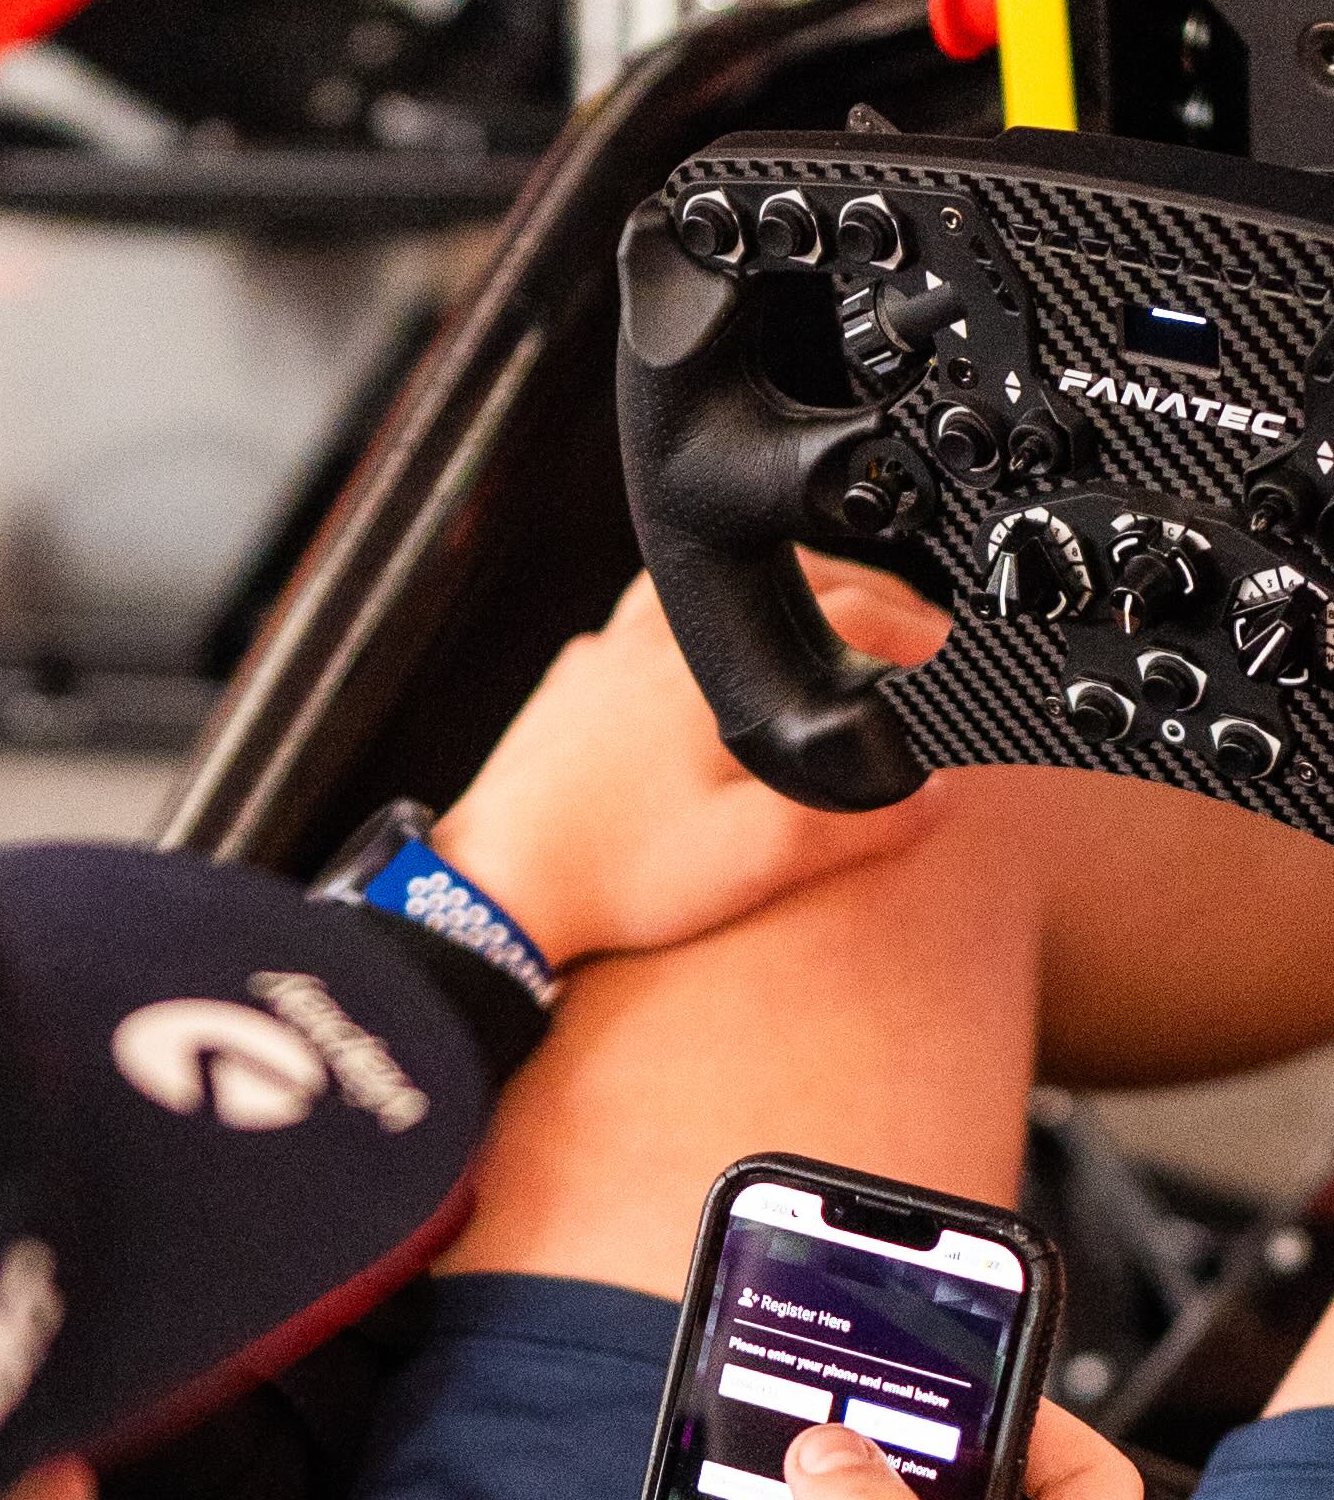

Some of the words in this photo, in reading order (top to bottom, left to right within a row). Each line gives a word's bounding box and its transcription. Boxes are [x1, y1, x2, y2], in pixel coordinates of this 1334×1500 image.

[1058, 368, 1287, 440] FANATEC
[760, 1294, 817, 1323] Register
[818, 1310, 852, 1333] Here
[729, 1335, 767, 1357] Please
[767, 1348, 797, 1366] enter
[797, 1357, 824, 1373] your
[823, 1363, 859, 1382] phone
[858, 1374, 882, 1390] and
[882, 1379, 914, 1399] email
[914, 1387, 950, 1409] below
[885, 1453, 902, 1471] lid
[901, 1458, 938, 1481] phone
